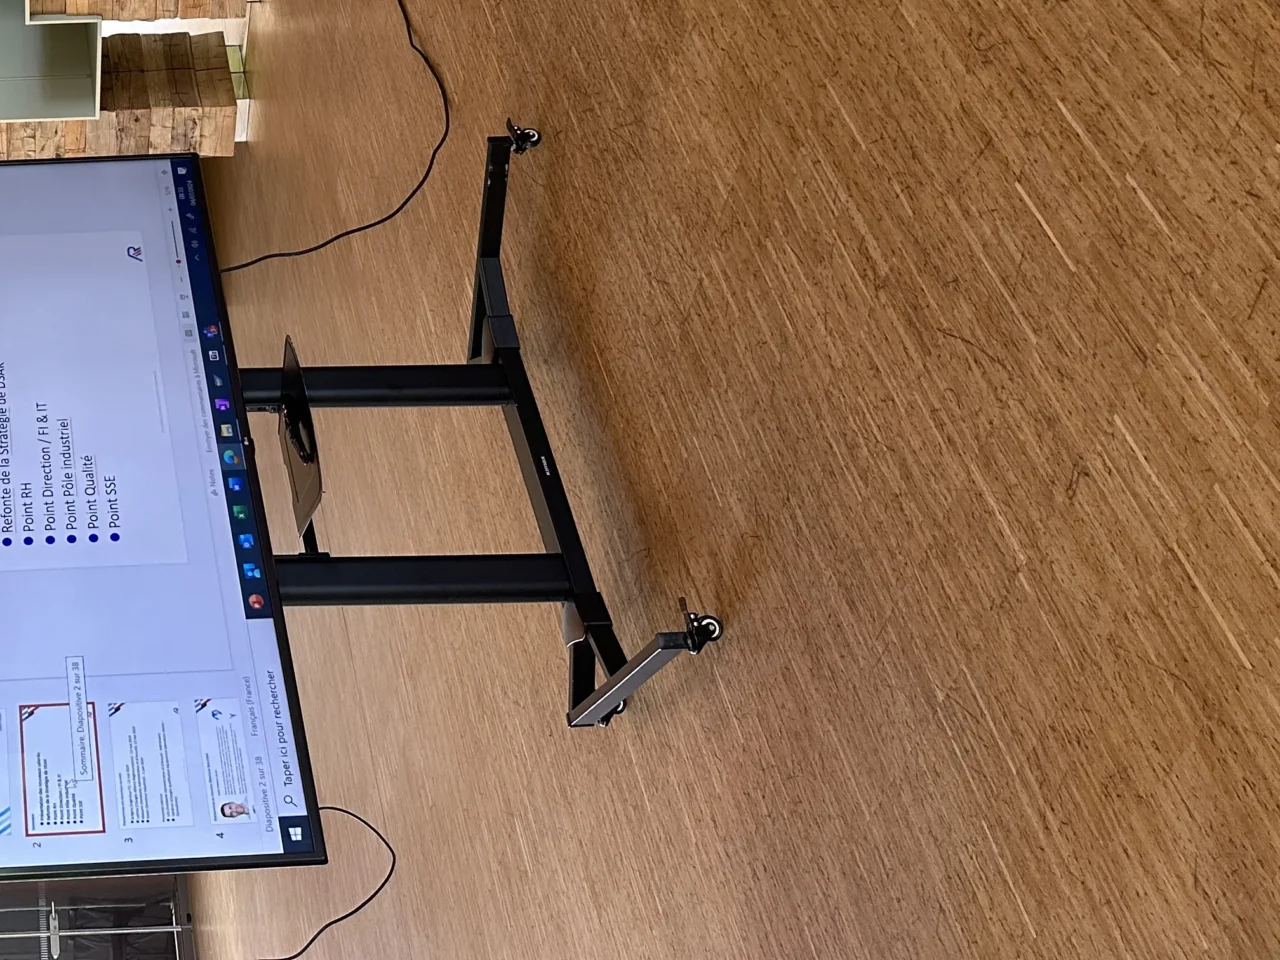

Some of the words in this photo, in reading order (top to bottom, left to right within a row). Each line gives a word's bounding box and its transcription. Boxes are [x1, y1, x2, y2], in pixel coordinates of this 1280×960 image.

[190, 349, 200, 374] Microsoft
[36, 402, 47, 411] IT
[196, 380, 207, 417] commentaires
[36, 415, 48, 423] &
[37, 426, 49, 436] FI
[57, 418, 72, 469] industriel
[204, 430, 213, 452] Envoyer
[0, 471, 11, 484] de
[38, 447, 54, 497] Direction
[62, 472, 75, 497] Pôle
[81, 455, 96, 496] Qualité
[104, 475, 117, 495] SSE
[208, 469, 216, 487] Notes
[21, 482, 32, 498] RH
[0, 488, 13, 533] Refonte
[22, 502, 34, 532] Point
[44, 501, 56, 531] Point
[65, 500, 77, 530] Point
[86, 499, 99, 529] Point
[108, 498, 120, 528] Point
[72, 662, 79, 671] 38
[242, 676, 255, 705] (France)
[266, 670, 282, 718] rechercher
[74, 692, 85, 732] Diapositive
[247, 706, 259, 736] Français
[276, 722, 290, 743] pour
[255, 756, 263, 765] 38
[277, 746, 288, 758] ici
[258, 767, 266, 779] sur
[281, 760, 295, 787] Taper
[260, 789, 274, 832] Diapositive
